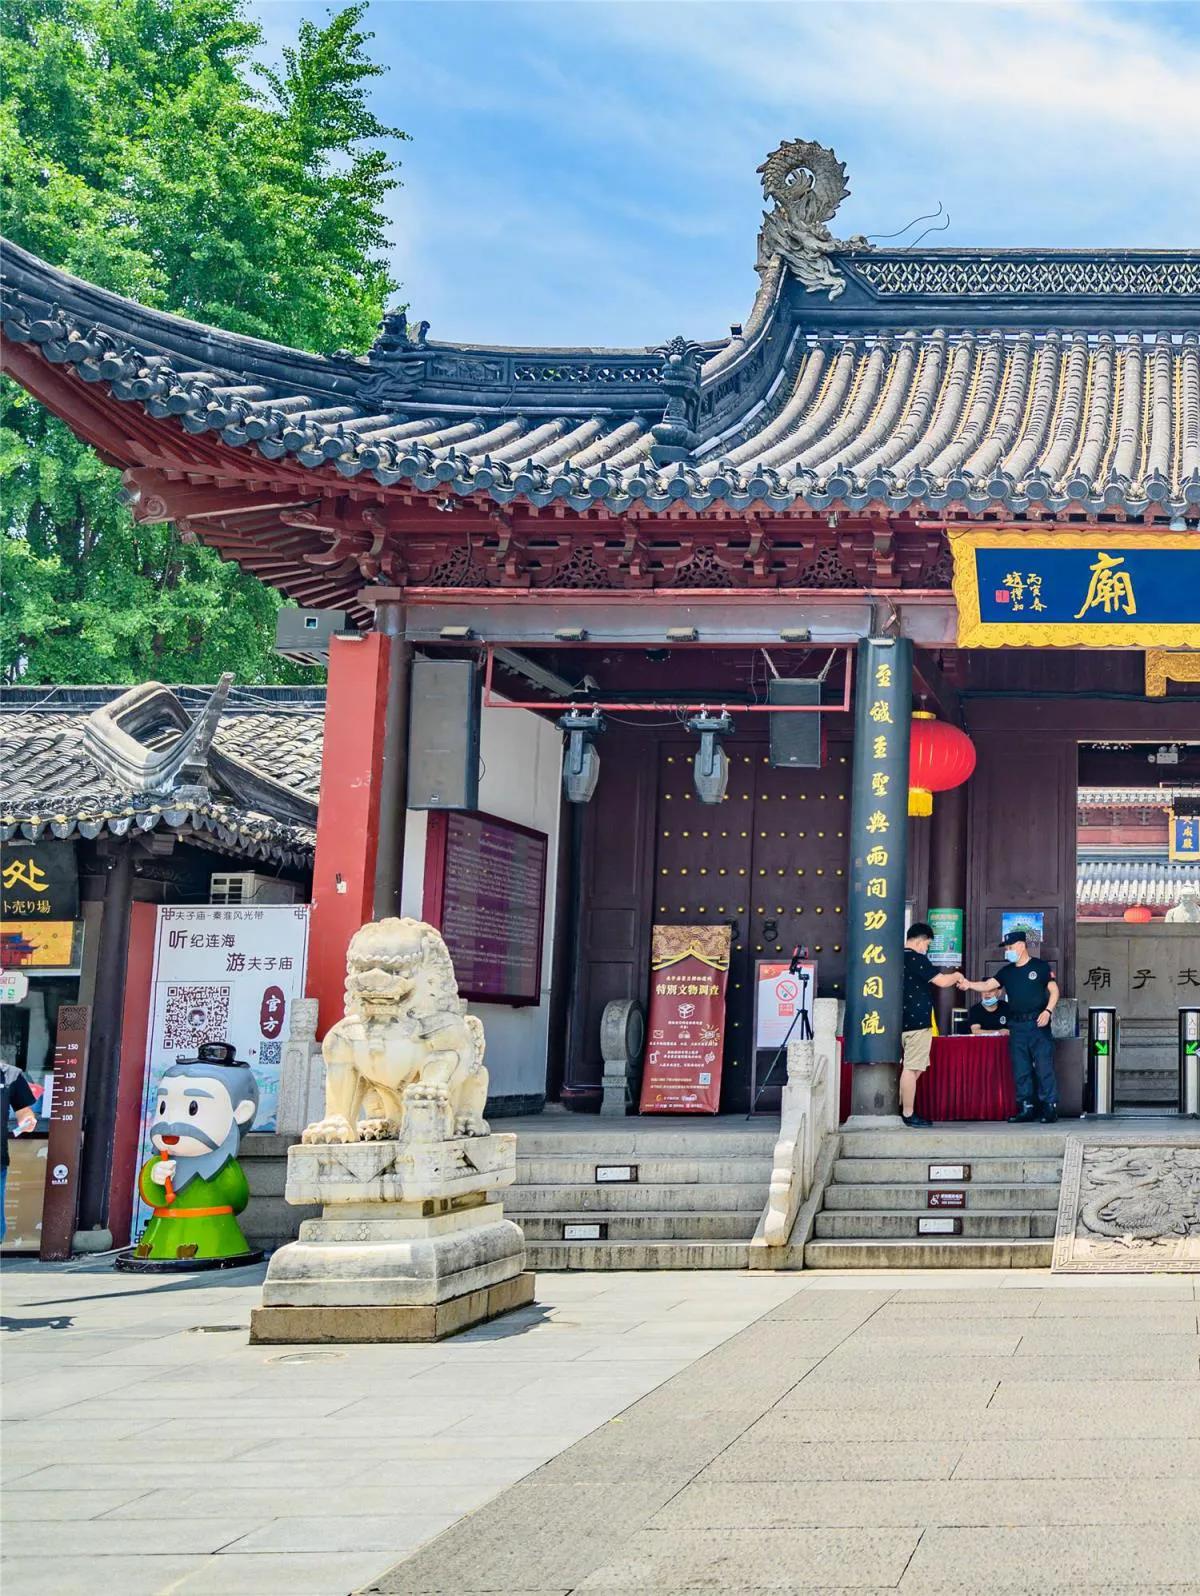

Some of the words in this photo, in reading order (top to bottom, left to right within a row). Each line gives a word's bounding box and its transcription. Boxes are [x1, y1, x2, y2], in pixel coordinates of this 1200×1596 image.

[168, 929, 236, 949] 听纪连海
[225, 952, 294, 972] 游夫子庙
[263, 995, 281, 1033] 官方
